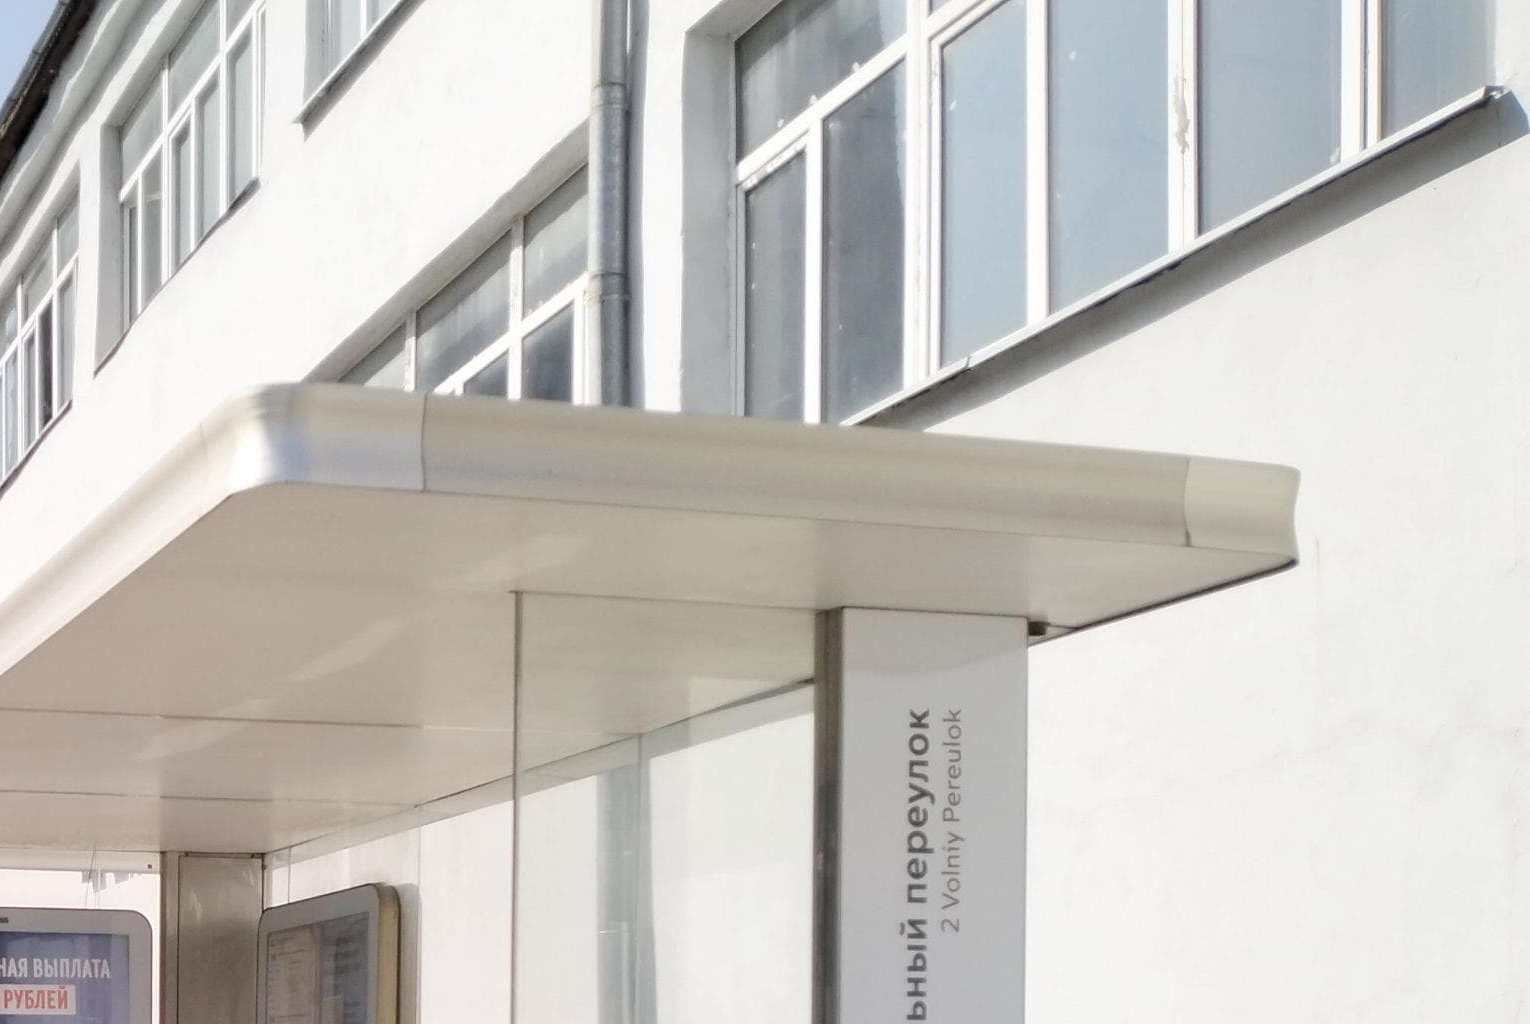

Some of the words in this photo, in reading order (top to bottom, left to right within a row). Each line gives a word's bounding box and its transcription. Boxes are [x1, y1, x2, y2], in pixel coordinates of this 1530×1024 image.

[942, 707, 963, 824] Pereulok
[906, 707, 936, 904] переулок
[941, 832, 966, 910] Volniy
[941, 917, 961, 934] 2
[33, 958, 112, 979] ВЫПЛАТА
[4, 985, 69, 1010] РУБЛЕЙ
